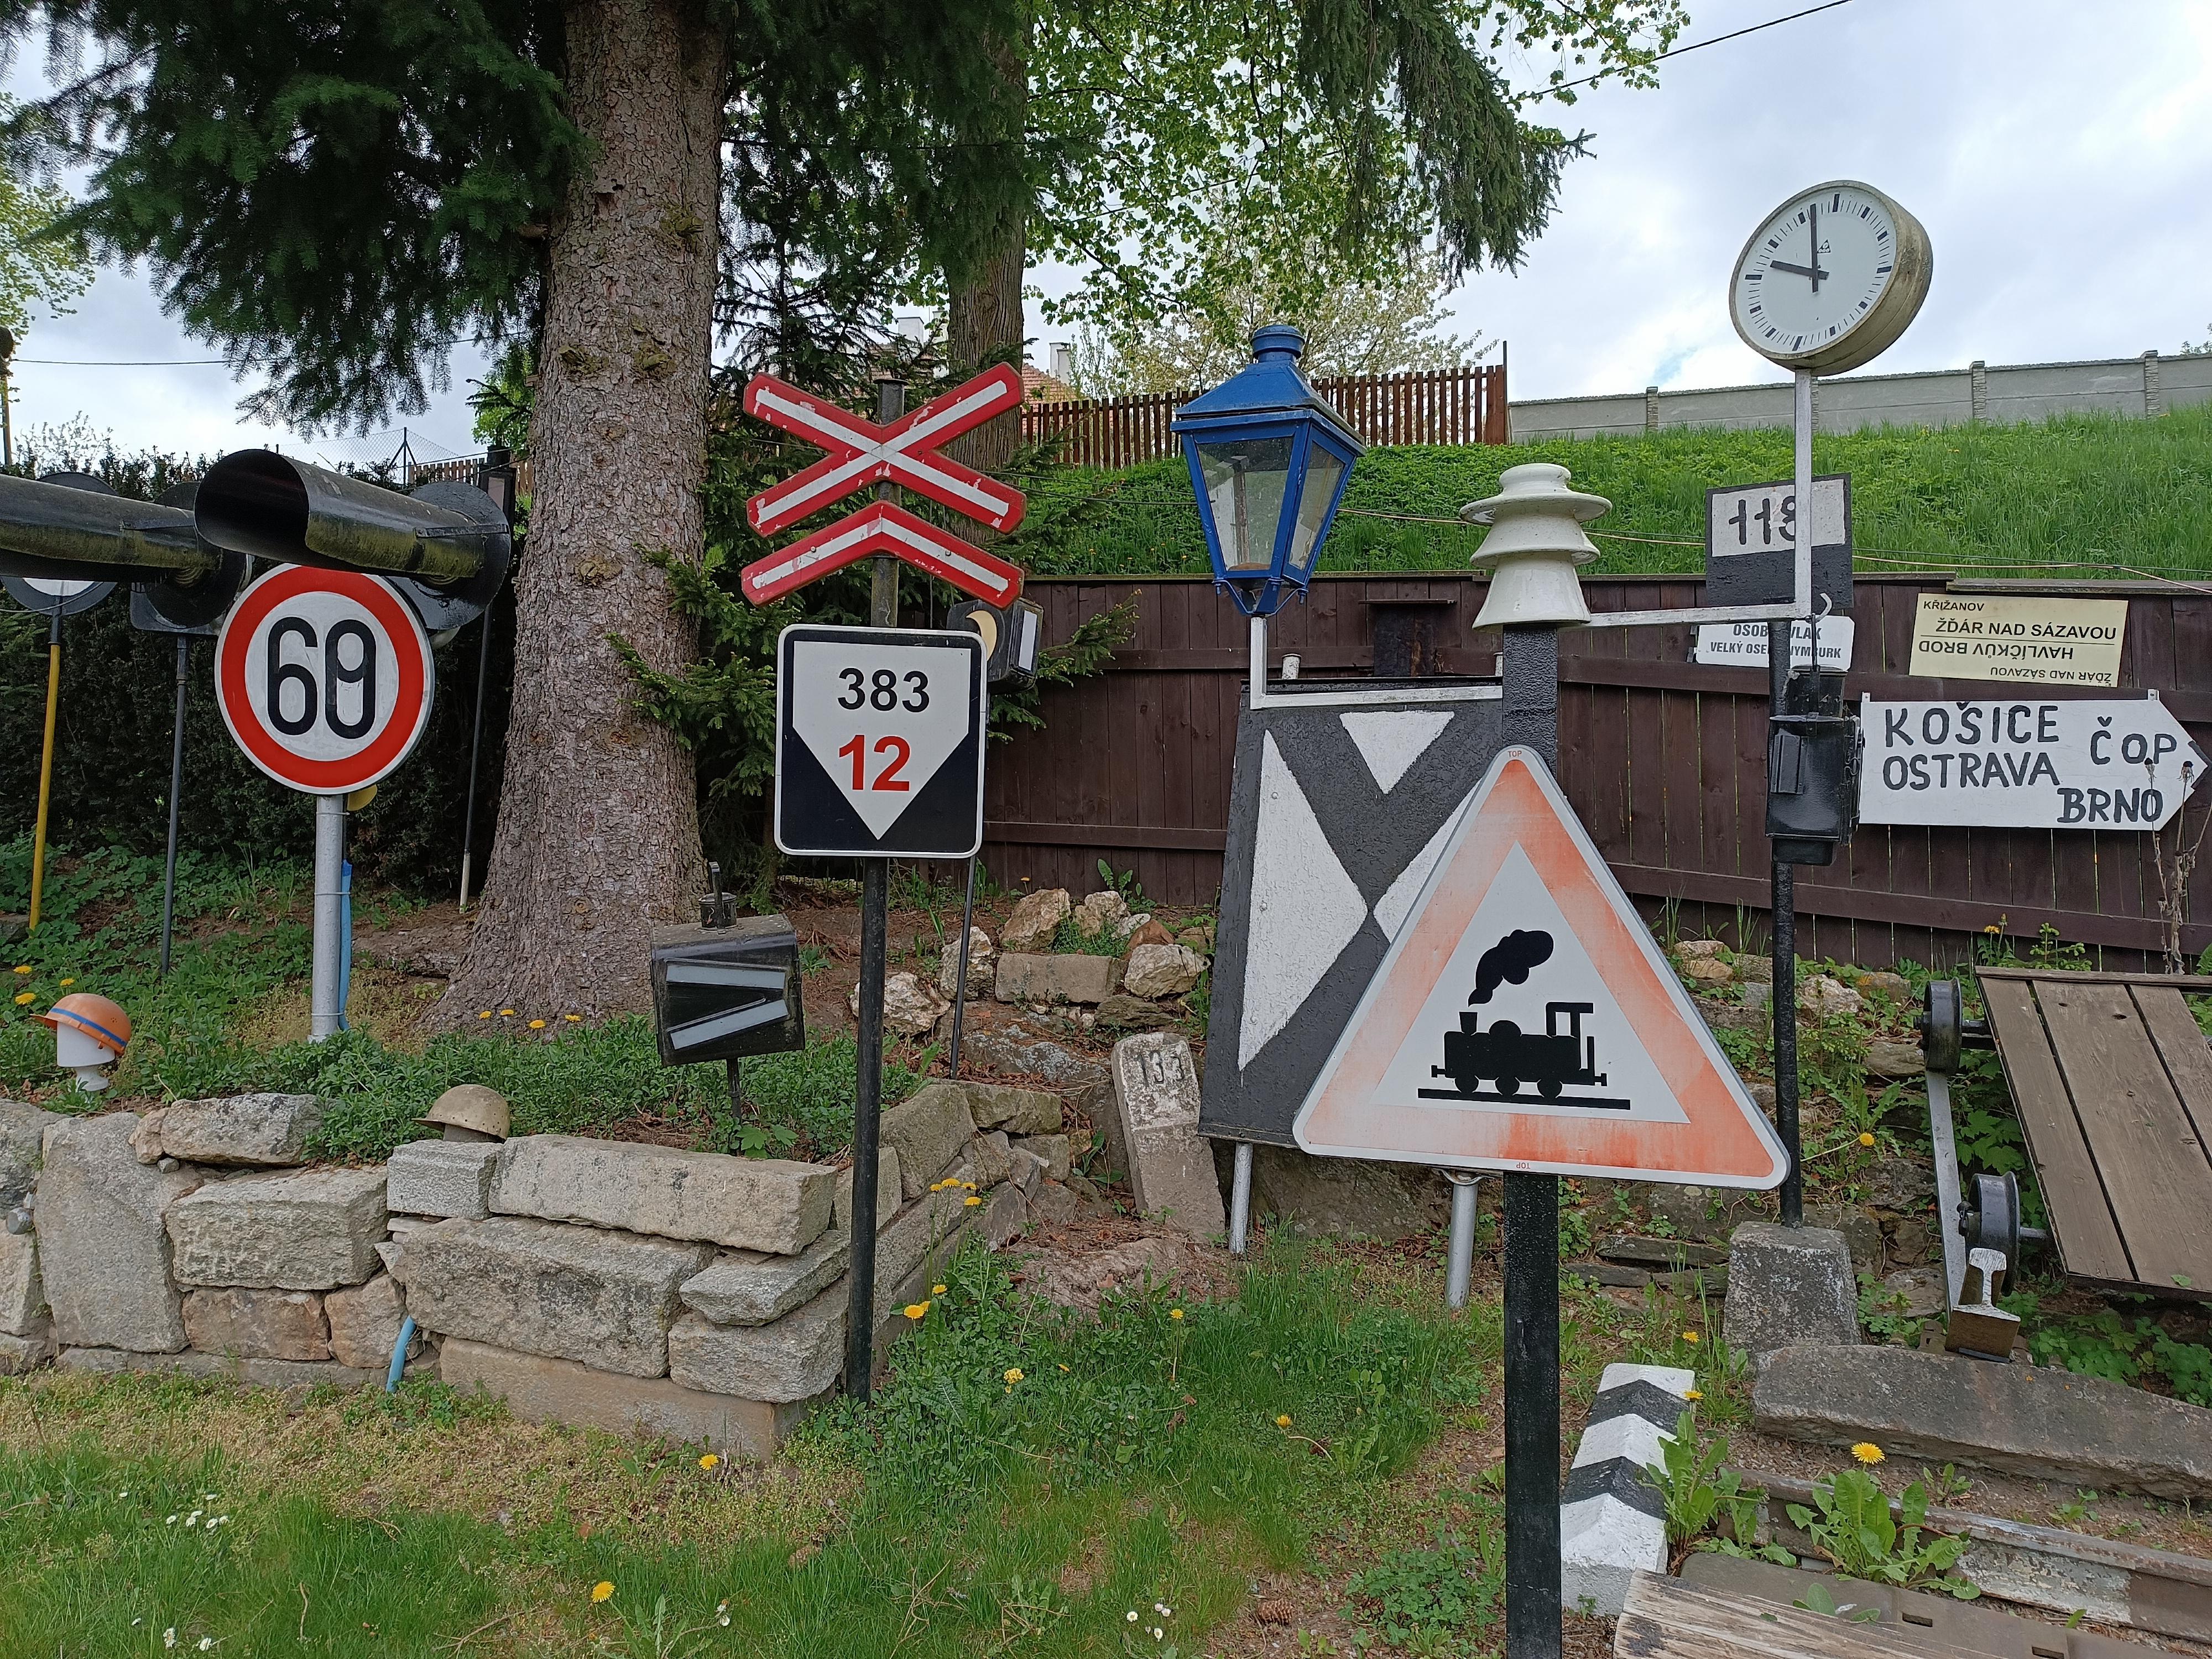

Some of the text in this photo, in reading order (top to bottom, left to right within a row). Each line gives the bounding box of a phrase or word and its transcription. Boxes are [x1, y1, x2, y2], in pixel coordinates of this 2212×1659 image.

[1923, 599, 1985, 612] KŘIŽANOV
[1733, 624, 1768, 637] OSOB
[1936, 618, 2116, 640] ŽĎÁR NAD SÁZAVOU
[1710, 641, 1841, 659] VELKÝ OSE YMURK
[1918, 640, 2074, 660] HAVLÍČKŮV BROD
[837, 667, 930, 713] 383
[1990, 667, 2112, 684] ŽĎÁR NAD SÁZAVOU
[1885, 701, 2059, 748] KOŠICE
[2090, 716, 2177, 765] ČOP
[838, 734, 911, 791] 12
[1883, 752, 2060, 791] OSTRAVA
[2057, 787, 2163, 823] BRNO
